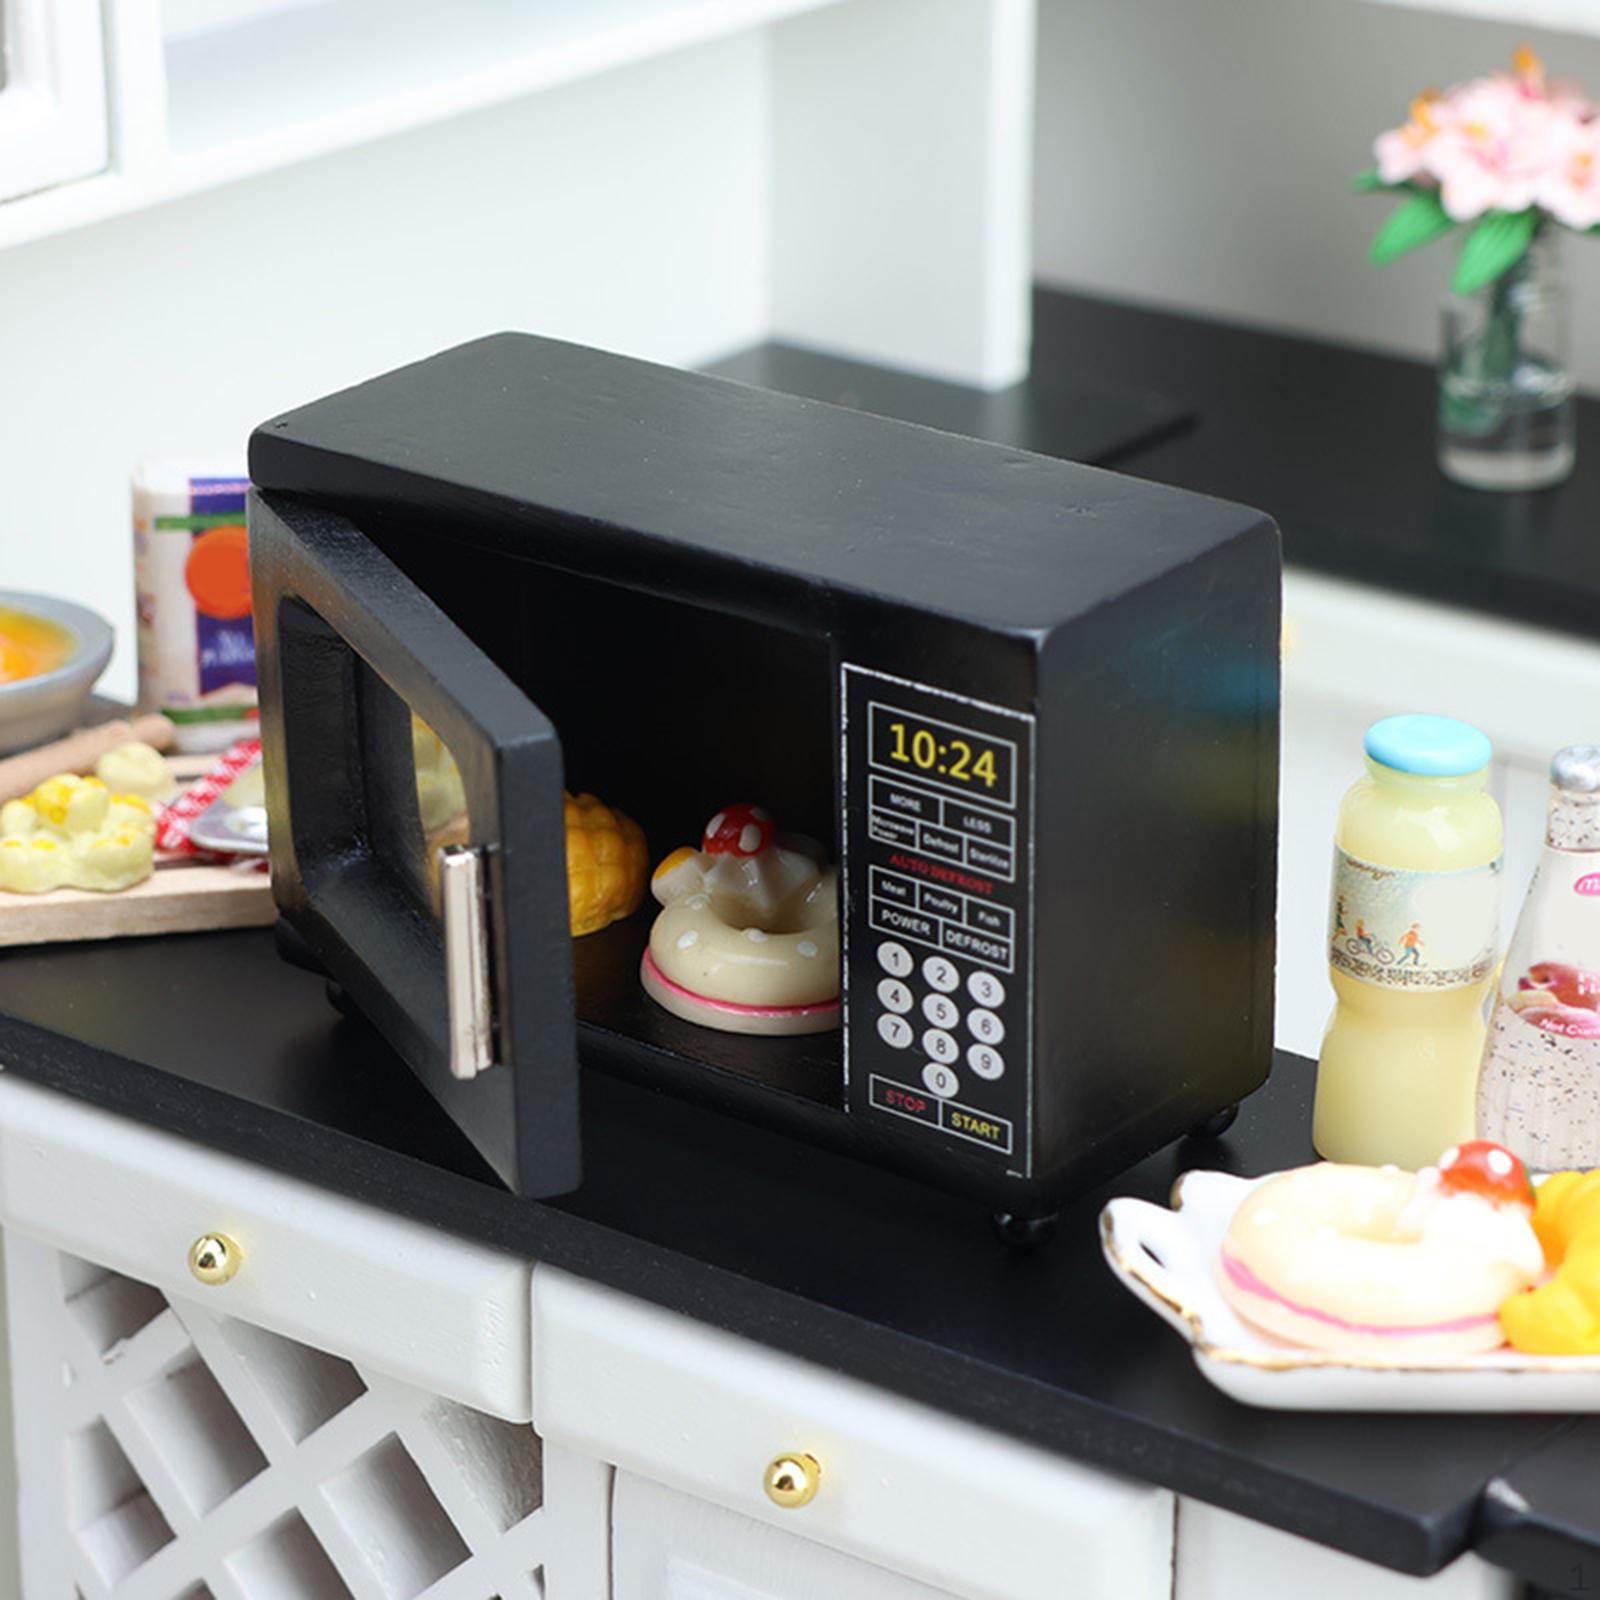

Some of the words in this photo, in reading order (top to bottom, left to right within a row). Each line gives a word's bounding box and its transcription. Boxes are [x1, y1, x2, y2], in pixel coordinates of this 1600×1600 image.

[889, 723, 997, 788] 10:24
[963, 815, 992, 834] LESS
[881, 880, 907, 897] Meat
[923, 893, 959, 915] Poultry
[881, 909, 931, 936] POWER
[978, 911, 1001, 927] Fish
[945, 930, 1009, 961] DEFROST
[892, 951, 899, 967] 1
[935, 966, 947, 983] 2
[890, 988, 901, 1003] 4
[981, 981, 992, 998] 3
[936, 1004, 947, 1020] 5
[891, 1022, 901, 1038] 7
[981, 1018, 992, 1035] 6
[935, 1038, 946, 1055] 8
[981, 1053, 991, 1070] 9
[935, 1072, 946, 1089] 0
[885, 1089, 928, 1112] STOP
[952, 1111, 1001, 1140] START
